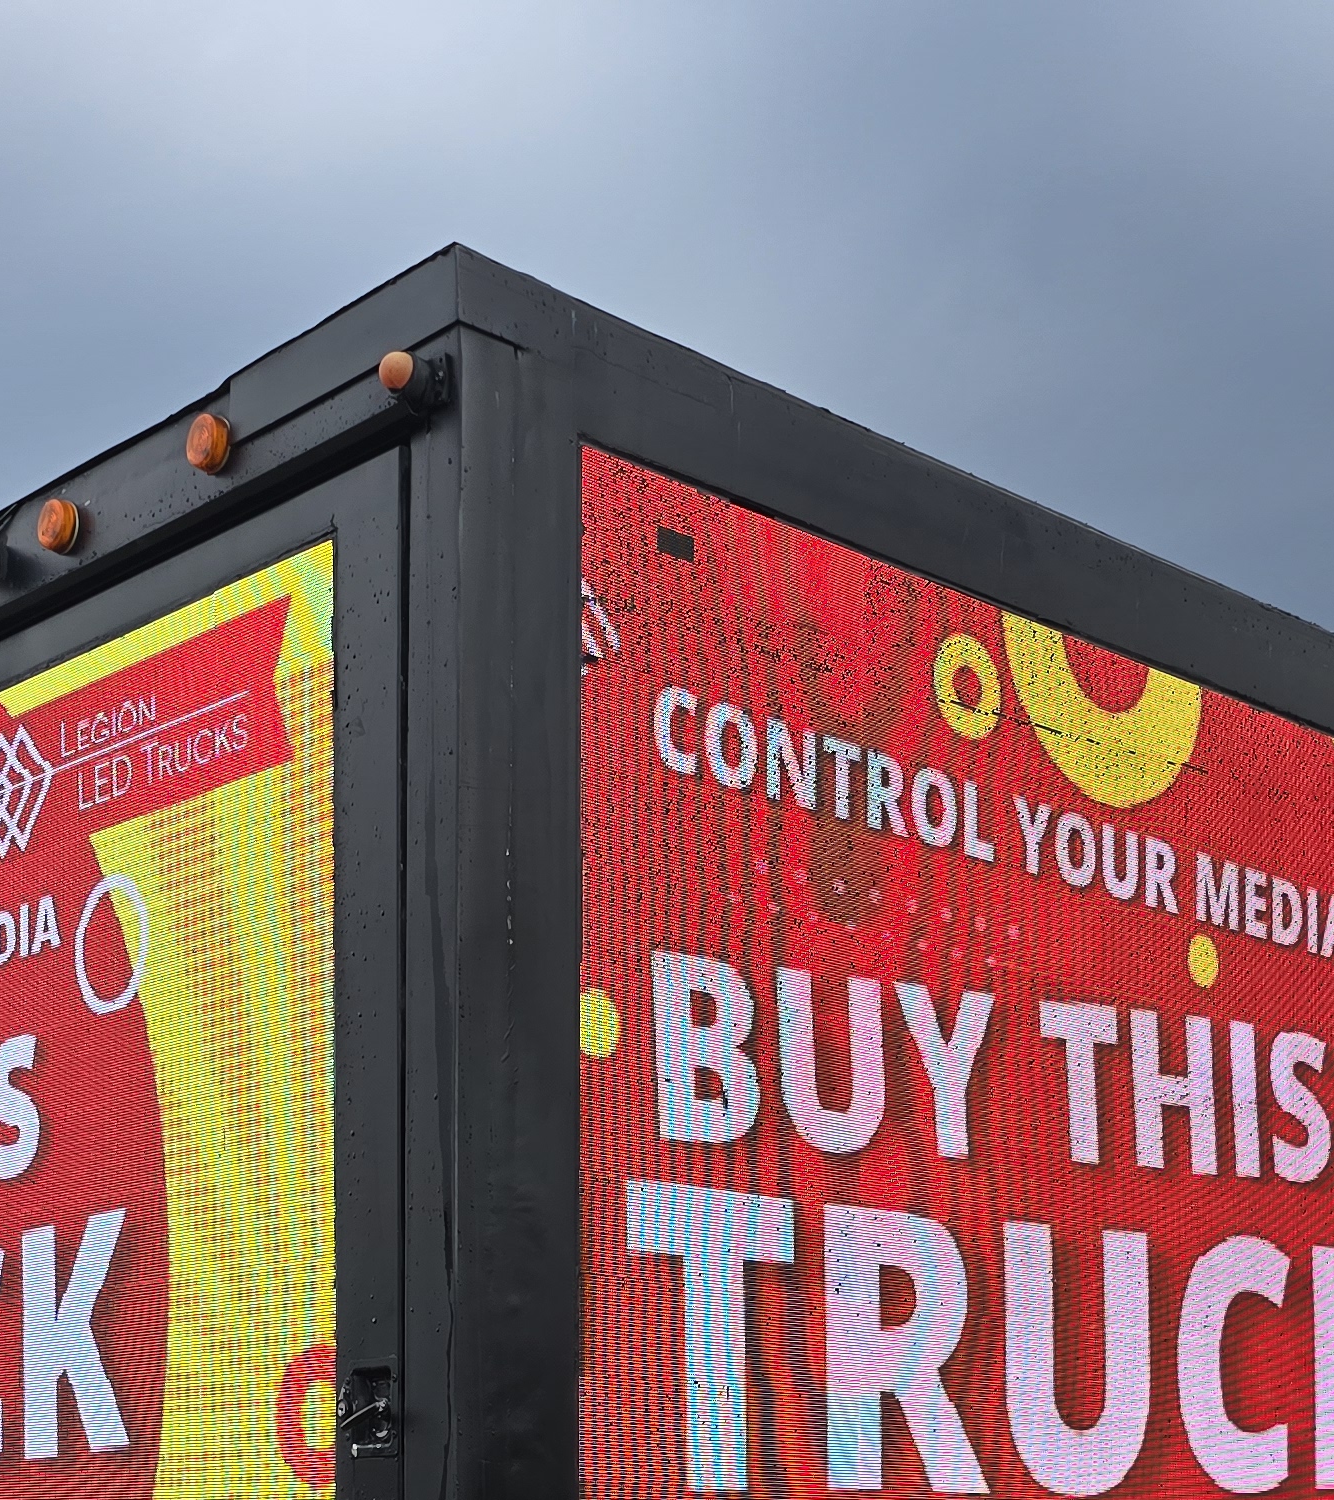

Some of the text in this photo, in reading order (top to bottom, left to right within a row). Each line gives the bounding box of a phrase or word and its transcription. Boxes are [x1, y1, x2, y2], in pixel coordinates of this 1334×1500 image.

[76, 754, 133, 811] LED
[651, 683, 995, 864] CONTROL
[1012, 793, 1181, 916] YOUR
[650, 949, 1332, 1184] BUY THIS
